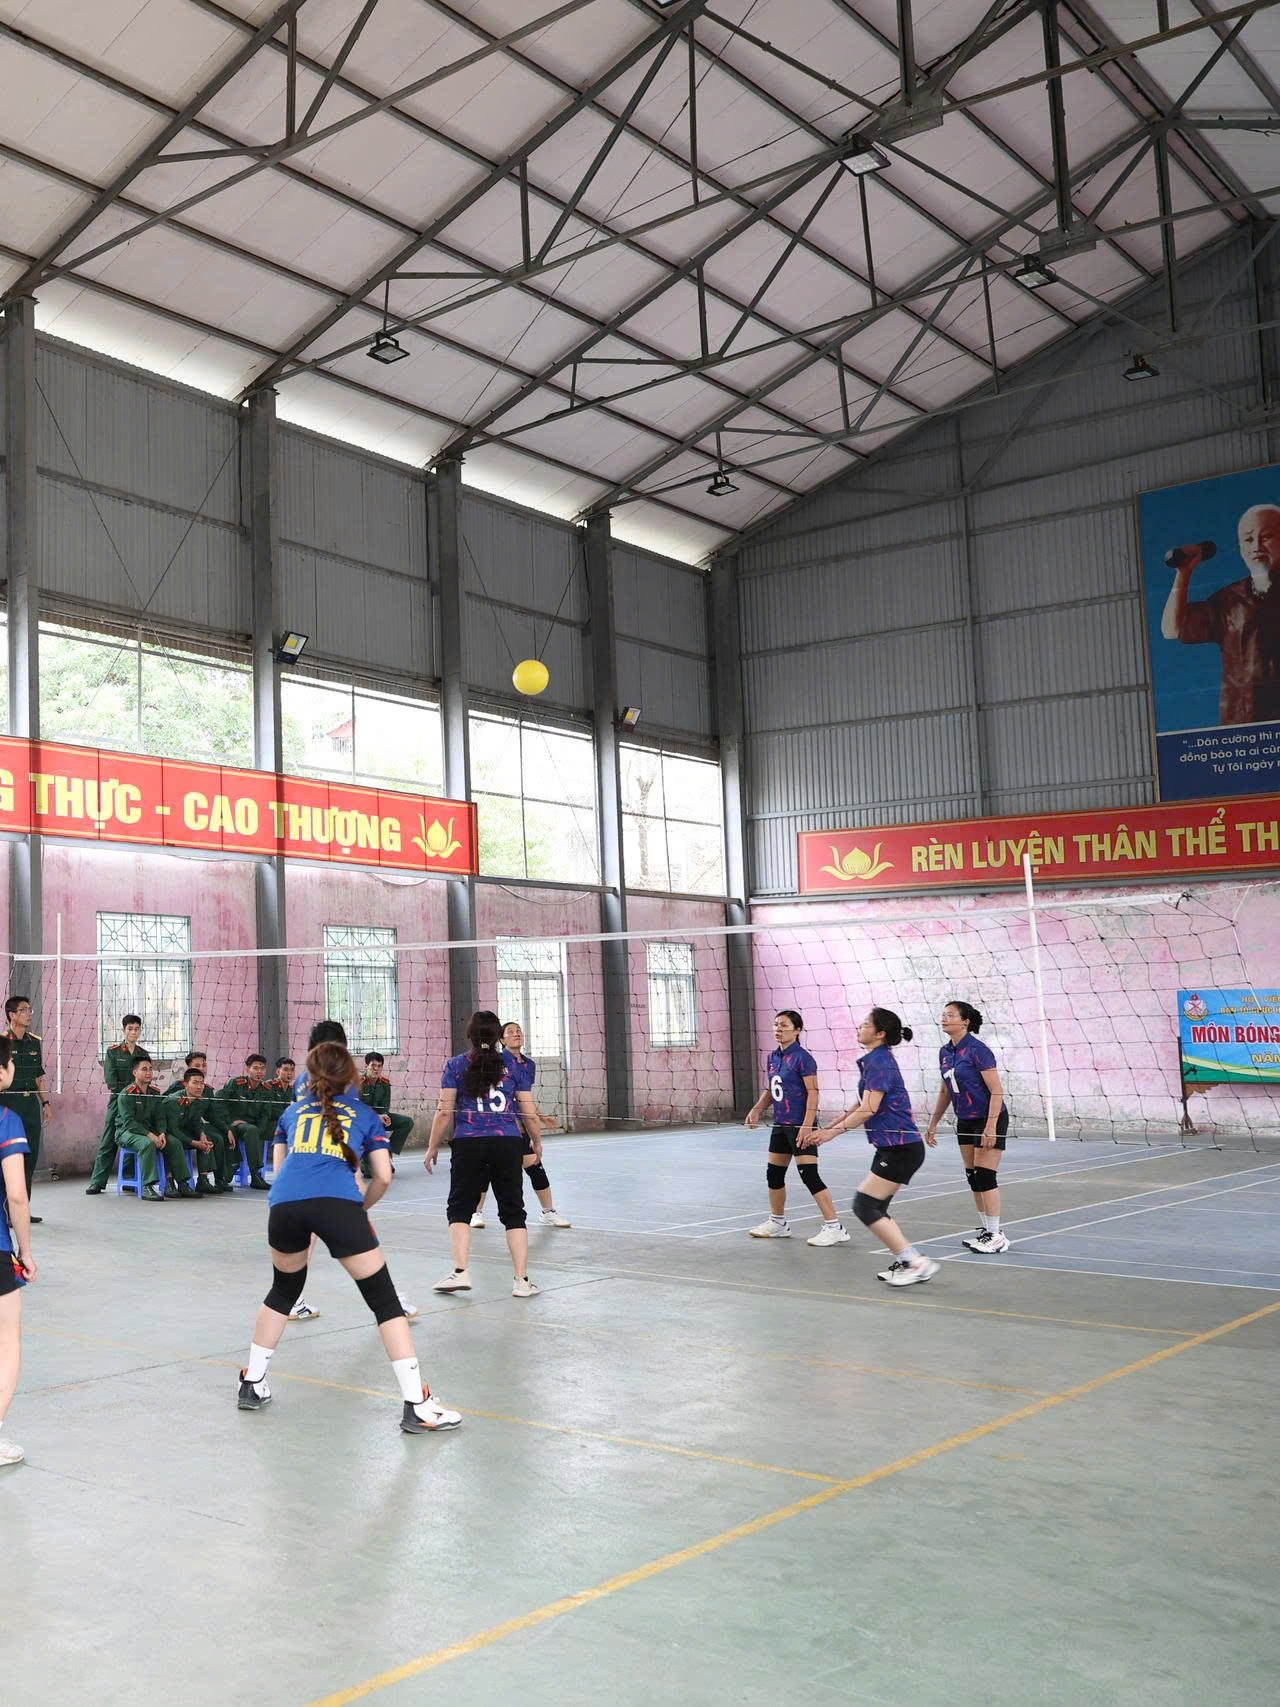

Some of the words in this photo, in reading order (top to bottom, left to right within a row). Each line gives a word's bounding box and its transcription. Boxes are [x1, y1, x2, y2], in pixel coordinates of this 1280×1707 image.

[29, 772, 142, 830] THỰC
[183, 791, 259, 836] CAO
[269, 801, 402, 855] THƯỢNG
[911, 837, 964, 873] RÈN
[971, 830, 1065, 874] LUYỆN
[1072, 823, 1157, 863] THÂN
[1165, 807, 1228, 857] THỂ
[1191, 1022, 1230, 1043] MÔN
[1234, 1022, 1280, 1043] BÓNG
[770, 1074, 784, 1102] 6
